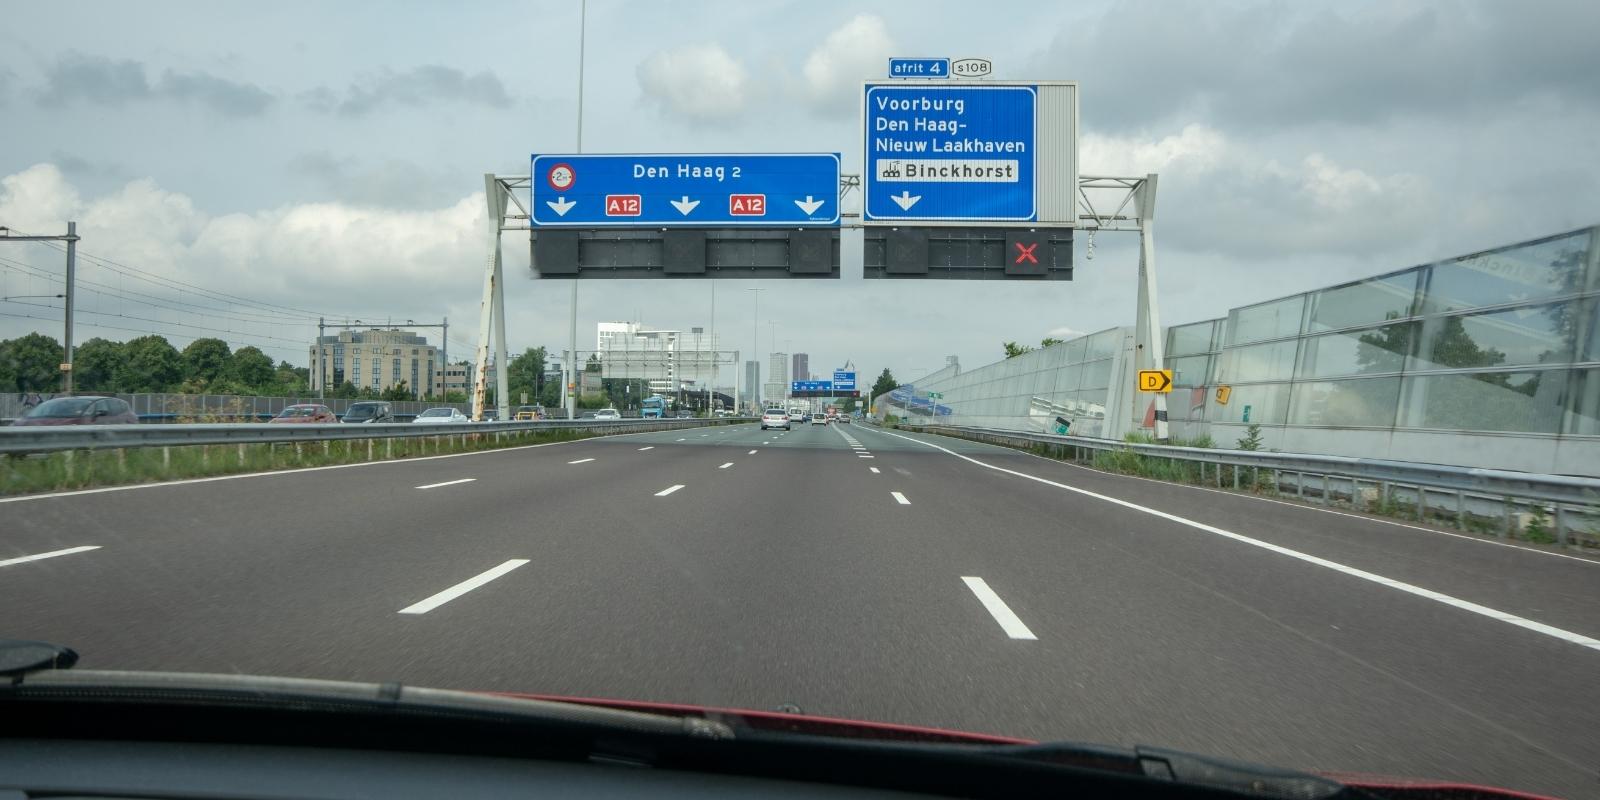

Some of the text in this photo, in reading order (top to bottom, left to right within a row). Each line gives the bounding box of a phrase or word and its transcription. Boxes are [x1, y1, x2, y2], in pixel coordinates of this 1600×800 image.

[894, 62, 941, 74] afrit 4
[957, 63, 988, 73] s108
[876, 96, 964, 115] Voorburg
[876, 117, 967, 135] Den Haag-
[876, 138, 1025, 152] Nieuw Laakhaven
[633, 164, 742, 181] Den Haag 2
[905, 163, 1013, 178] Binckhorst
[608, 199, 638, 212] A12
[732, 199, 762, 211] A12
[1148, 376, 1158, 387] D
